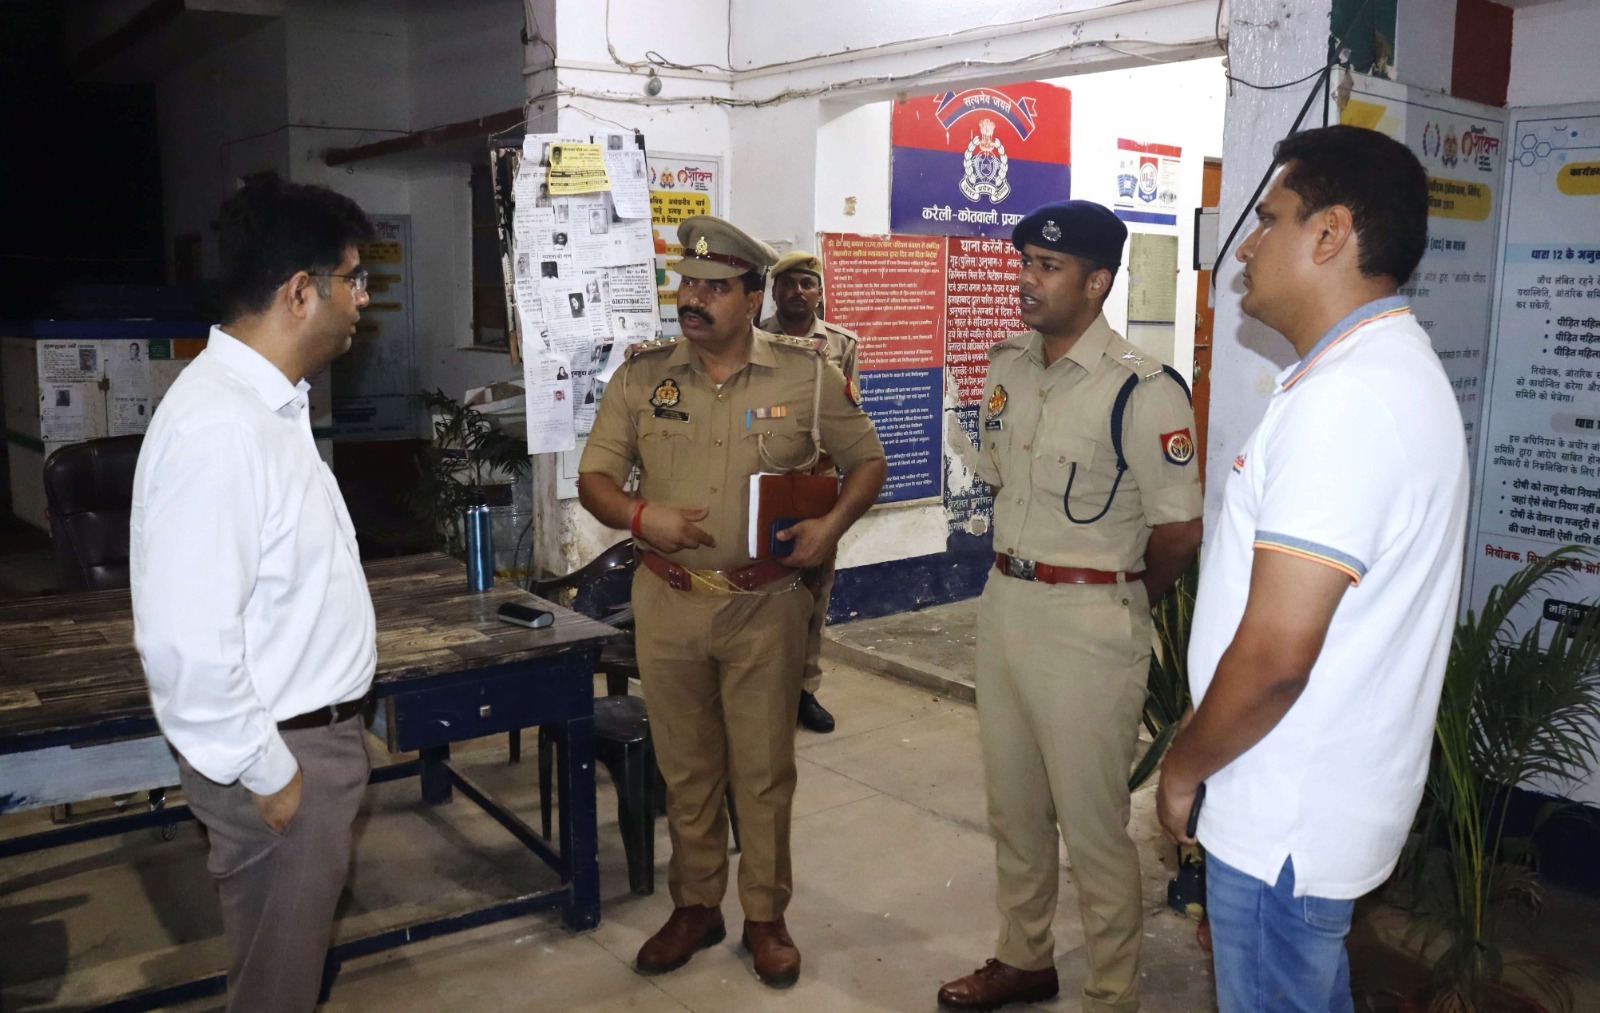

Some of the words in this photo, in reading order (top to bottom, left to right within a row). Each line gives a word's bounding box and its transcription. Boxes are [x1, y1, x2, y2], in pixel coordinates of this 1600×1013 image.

[963, 90, 990, 106] सत्यमेव
[992, 96, 1011, 113] जयते
[960, 239, 981, 252] थाना
[1531, 249, 1550, 260] धारा
[1552, 249, 1563, 260] 12
[1566, 247, 1574, 260] के
[1555, 274, 1575, 286] लंबित
[1579, 275, 1594, 287] रहने
[1555, 287, 1583, 299] आंतरिक
[1516, 300, 1526, 310] कर
[1557, 316, 1579, 329] पीड़ित
[1581, 317, 1600, 330] महिल
[1555, 331, 1577, 343] पीड़ित
[1579, 332, 1600, 344] महिल
[1554, 346, 1576, 359] पीड़ित
[1531, 364, 1561, 378] नियोजक,
[1565, 367, 1593, 379] आंतरिक
[1516, 376, 1525, 386] को
[1564, 379, 1583, 390] करेगा
[1515, 388, 1536, 400] समिति
[1538, 390, 1548, 401] को
[1509, 434, 1520, 444] इस
[1523, 434, 1556, 447] अधिनियम
[1558, 437, 1565, 448] के
[1568, 439, 1589, 451] अधीन
[1494, 445, 1515, 455] समिति
[1519, 448, 1532, 458] द्वारा
[1536, 450, 1556, 460] आरोप
[1561, 451, 1583, 462] साबित
[1493, 457, 1521, 467] अधिकारी
[1523, 458, 1530, 469] से
[1571, 465, 1578, 475] के
[1580, 466, 1595, 478] लिए
[1512, 477, 1530, 490] दोषी
[1531, 480, 1541, 491] को
[1543, 483, 1559, 497] लागू
[1560, 484, 1575, 496] सेवा
[1511, 494, 1526, 506] जहां
[1528, 495, 1540, 507] ऐसे
[1542, 496, 1557, 509] सेवा
[1558, 499, 1579, 511] नियम
[1581, 501, 1595, 514] नहीं
[1509, 507, 1525, 520] दोषी
[1527, 510, 1535, 521] के
[1536, 511, 1552, 523] वेतन
[1554, 515, 1563, 525] या
[1565, 517, 1590, 531] मजदूरी
[1592, 519, 1600, 530] से
[1508, 522, 1518, 533] की
[1520, 524, 1536, 536] जाने
[1537, 526, 1555, 539] वाली
[1557, 528, 1573, 542] ऐसी
[1574, 532, 1591, 545] राशि
[1485, 544, 1523, 563] नियोजक,
